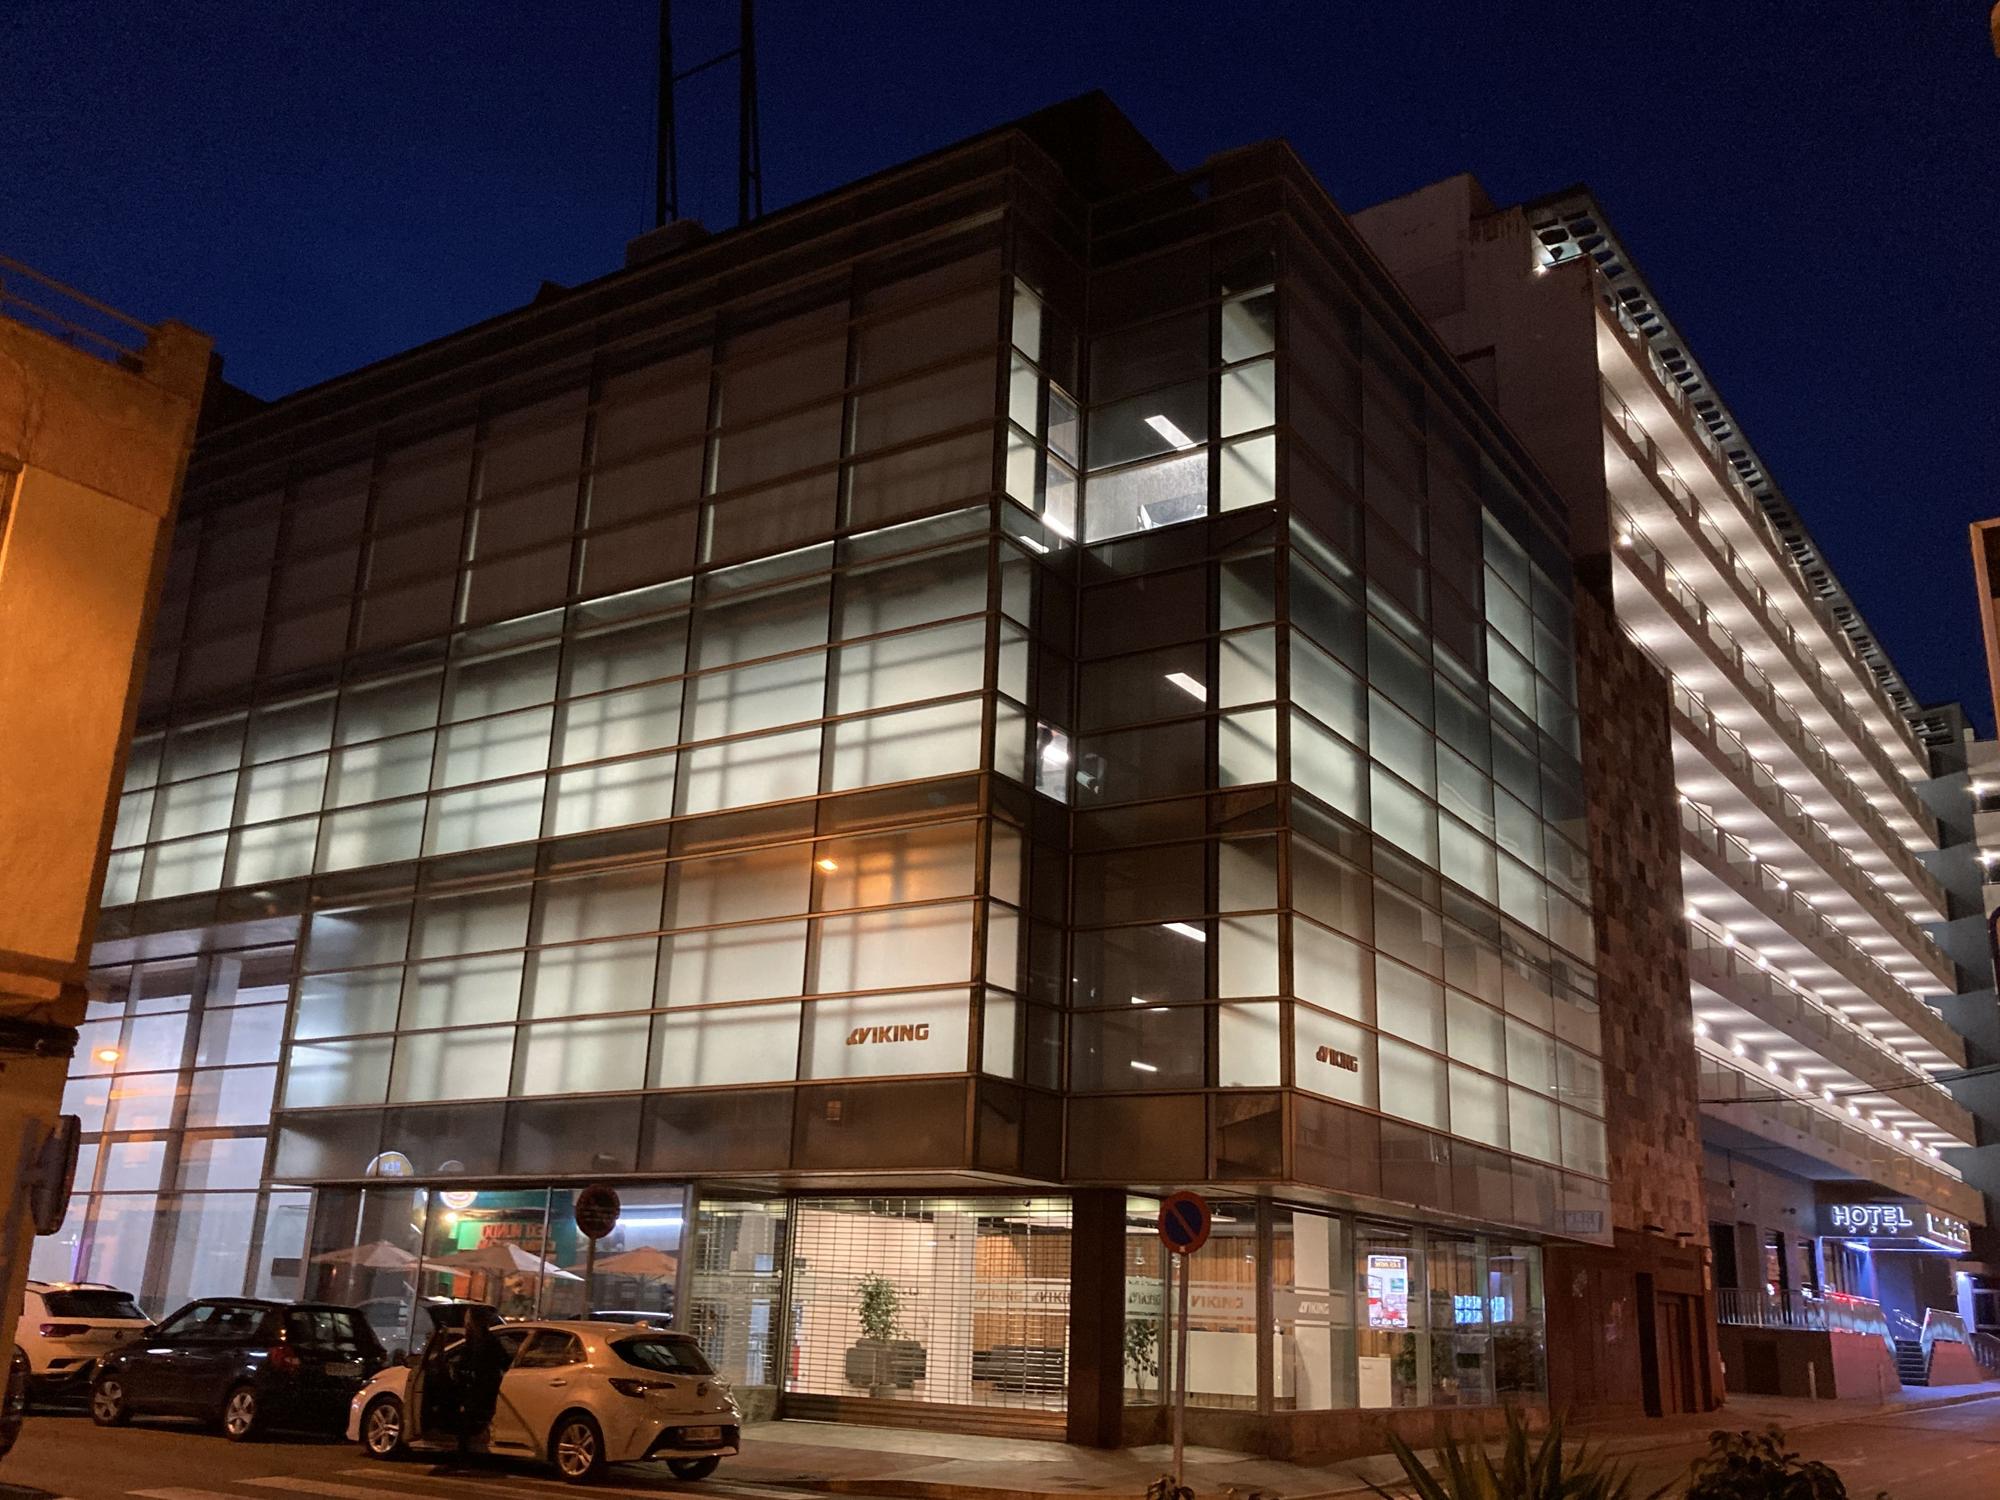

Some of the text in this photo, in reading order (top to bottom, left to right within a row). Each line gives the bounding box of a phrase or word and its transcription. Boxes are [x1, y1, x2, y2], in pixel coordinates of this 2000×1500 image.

[846, 1023, 929, 1045] VIKING
[1316, 1045, 1358, 1072] VIKING
[1832, 1205, 1913, 1226] HOTEL
[1190, 1295, 1244, 1309] VIKING
